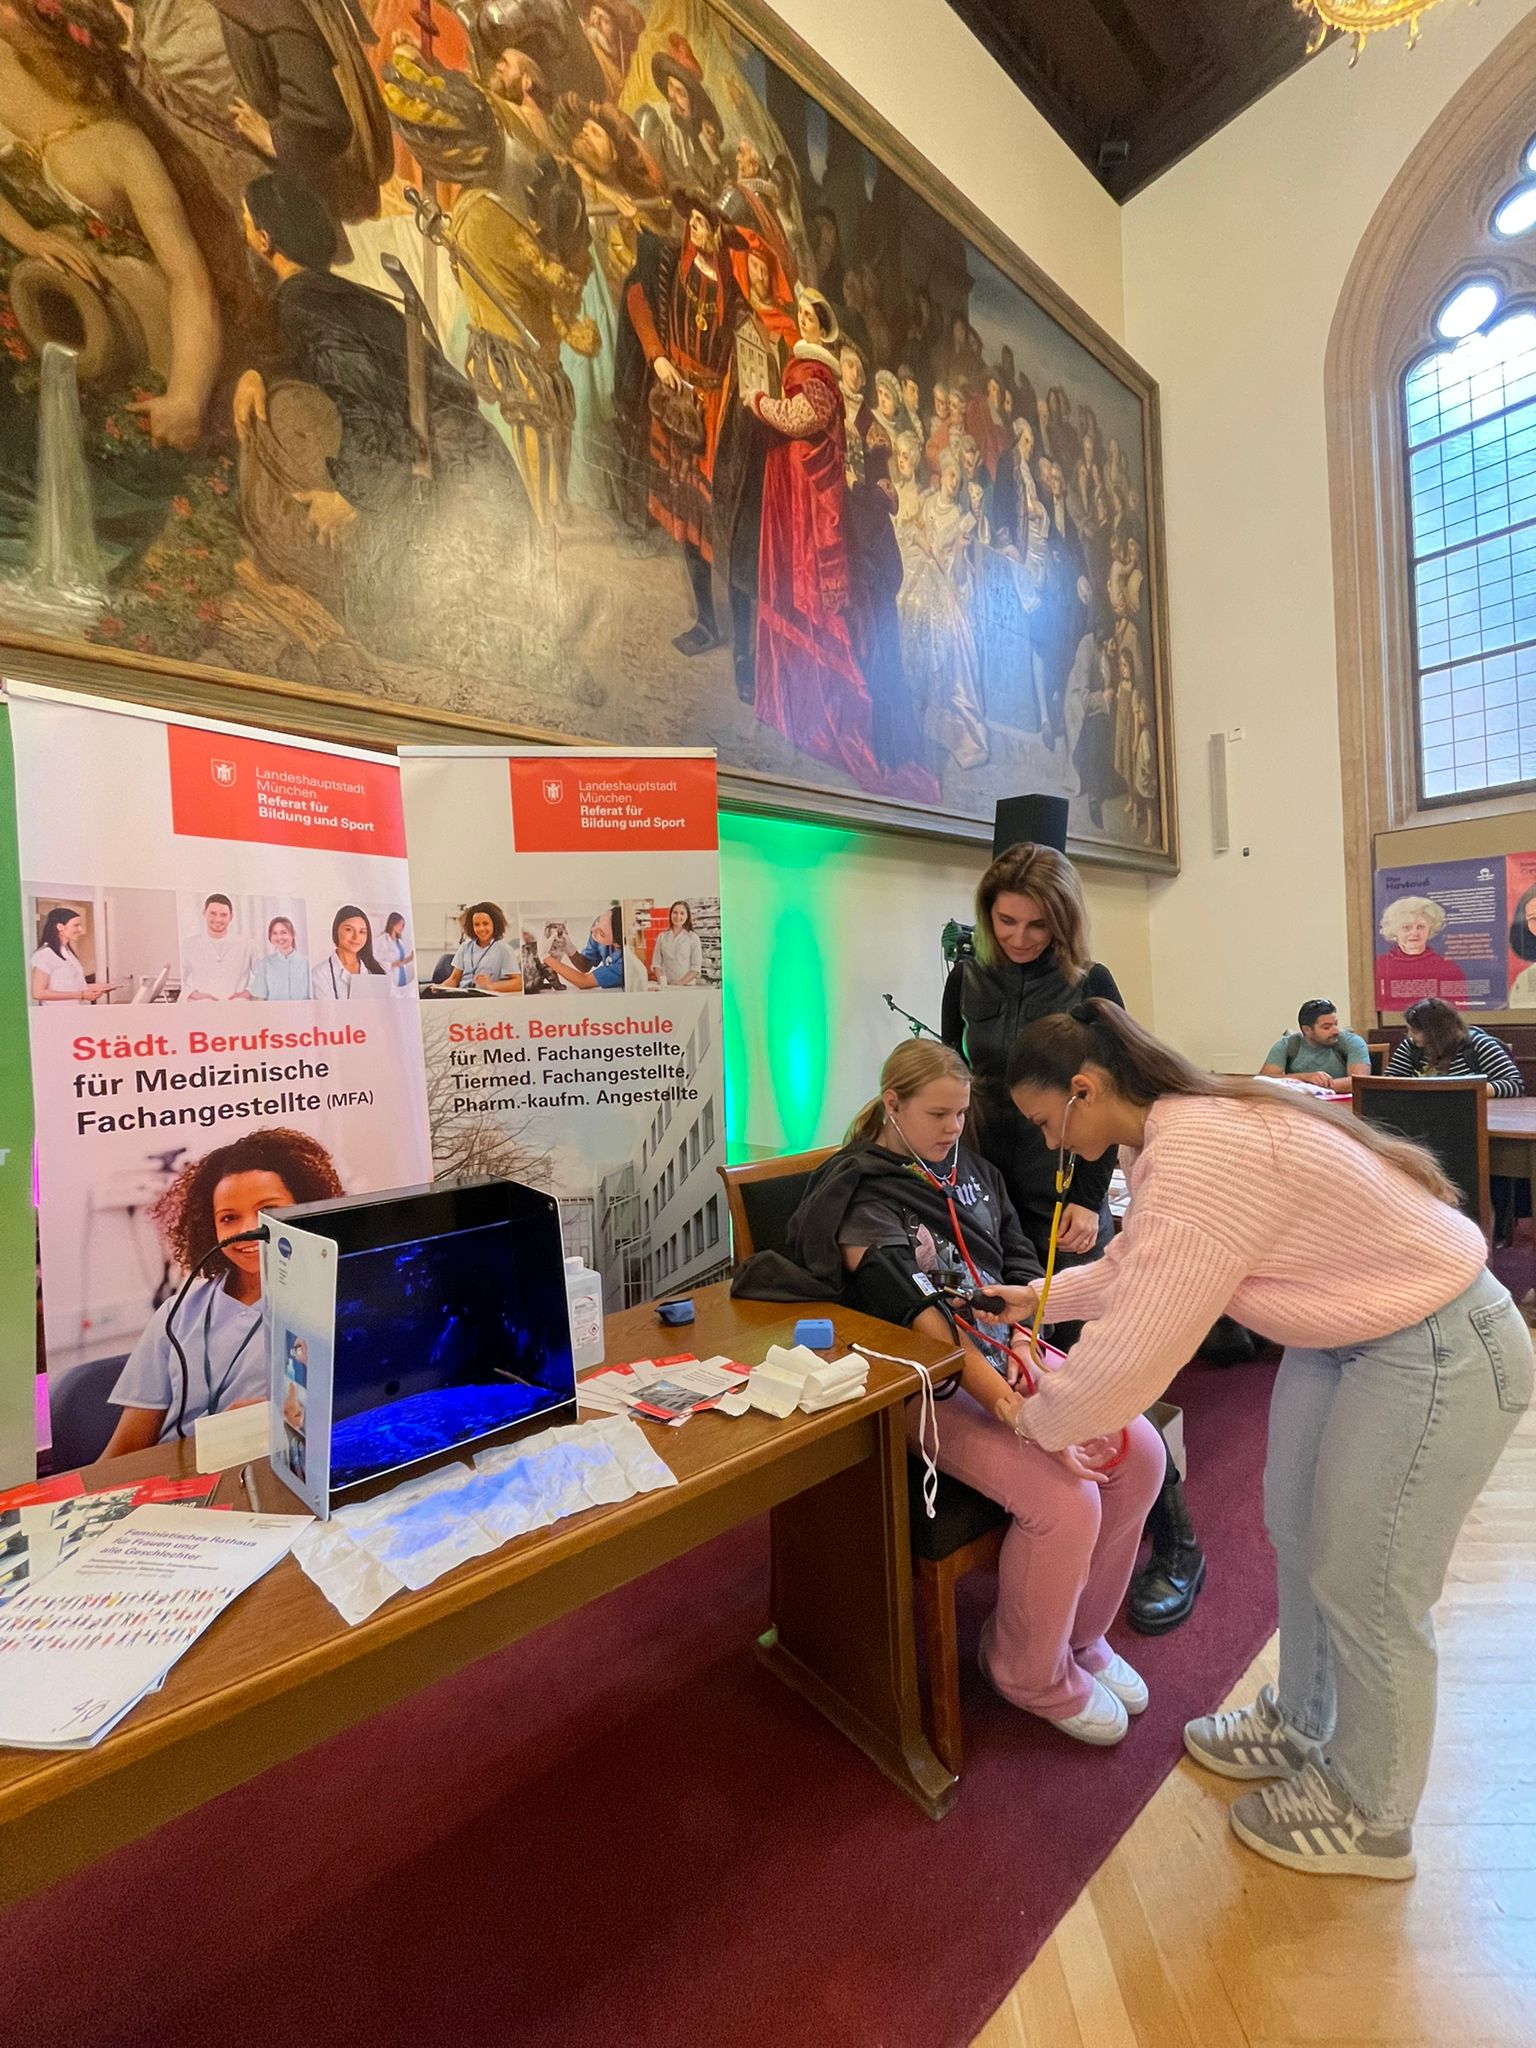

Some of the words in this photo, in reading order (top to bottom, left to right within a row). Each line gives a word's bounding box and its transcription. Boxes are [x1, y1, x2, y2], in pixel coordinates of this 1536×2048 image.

[256, 766, 365, 795] Landeshauptstadt
[256, 780, 317, 799] München
[578, 780, 677, 793] Landeshauptstadt
[257, 793, 306, 811] Referat
[310, 801, 329, 813] für
[579, 792, 632, 803] München
[258, 806, 311, 826] Bildung
[314, 813, 338, 828] und
[341, 817, 375, 831] Sport
[580, 805, 623, 816] Referat
[626, 805, 643, 816] für
[581, 817, 627, 830] Bildung
[629, 817, 651, 828] und
[653, 817, 685, 830] Sport
[448, 1022, 520, 1043] Städt.
[528, 1016, 674, 1039] Berufsschule
[72, 1033, 177, 1061] Städt.
[189, 1025, 367, 1054] Berufsschule
[450, 1050, 477, 1066] für
[483, 1047, 531, 1065] Med.
[537, 1042, 686, 1063] Fachangestellte,
[73, 1073, 123, 1098] für
[135, 1059, 330, 1093] Medizinische
[451, 1070, 536, 1090] Tiermed.
[542, 1065, 690, 1085] Fachangestellte,
[453, 1092, 590, 1113] Pharm.-kaufm.
[596, 1086, 699, 1107] Angestellte
[77, 1092, 321, 1135] Fachangestellte
[326, 1090, 375, 1111] (MFA)
[112, 1537, 131, 1545] für
[131, 1538, 172, 1548] Frauen
[124, 1528, 209, 1541] Feministisches
[210, 1536, 257, 1547] Rathaus
[100, 1546, 123, 1554] alle
[124, 1547, 202, 1560] Geschlechter
